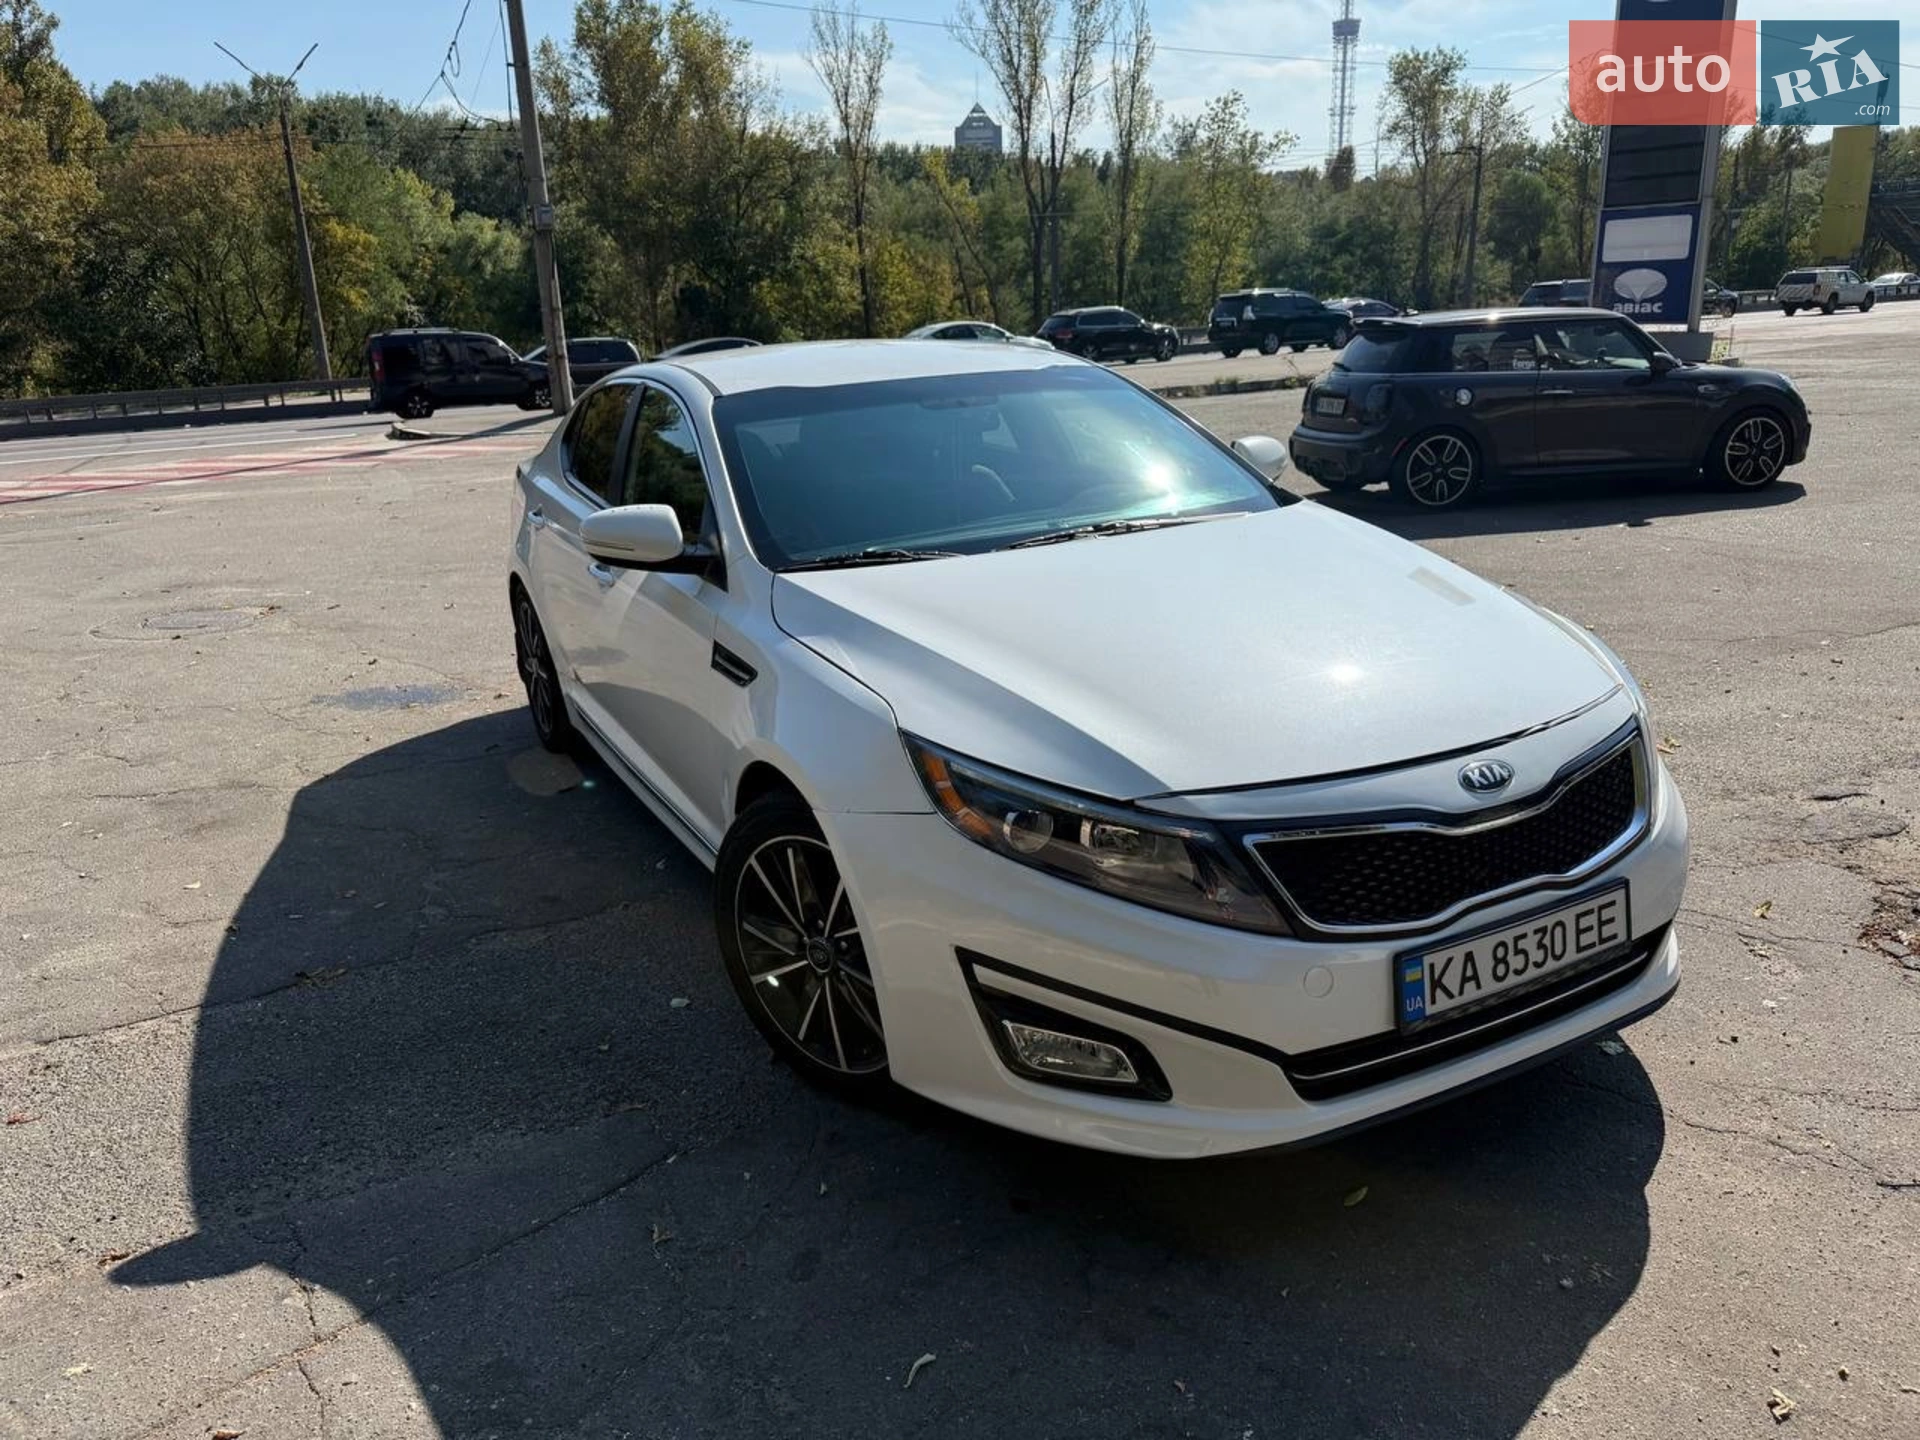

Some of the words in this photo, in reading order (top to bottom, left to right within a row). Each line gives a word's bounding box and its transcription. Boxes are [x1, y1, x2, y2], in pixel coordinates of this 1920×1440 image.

[1467, 764, 1510, 787] KIA
[1429, 951, 1481, 1005] KA
[1492, 920, 1567, 983] 8530
[1576, 899, 1618, 954] EE
[1406, 995, 1423, 1011] UA
